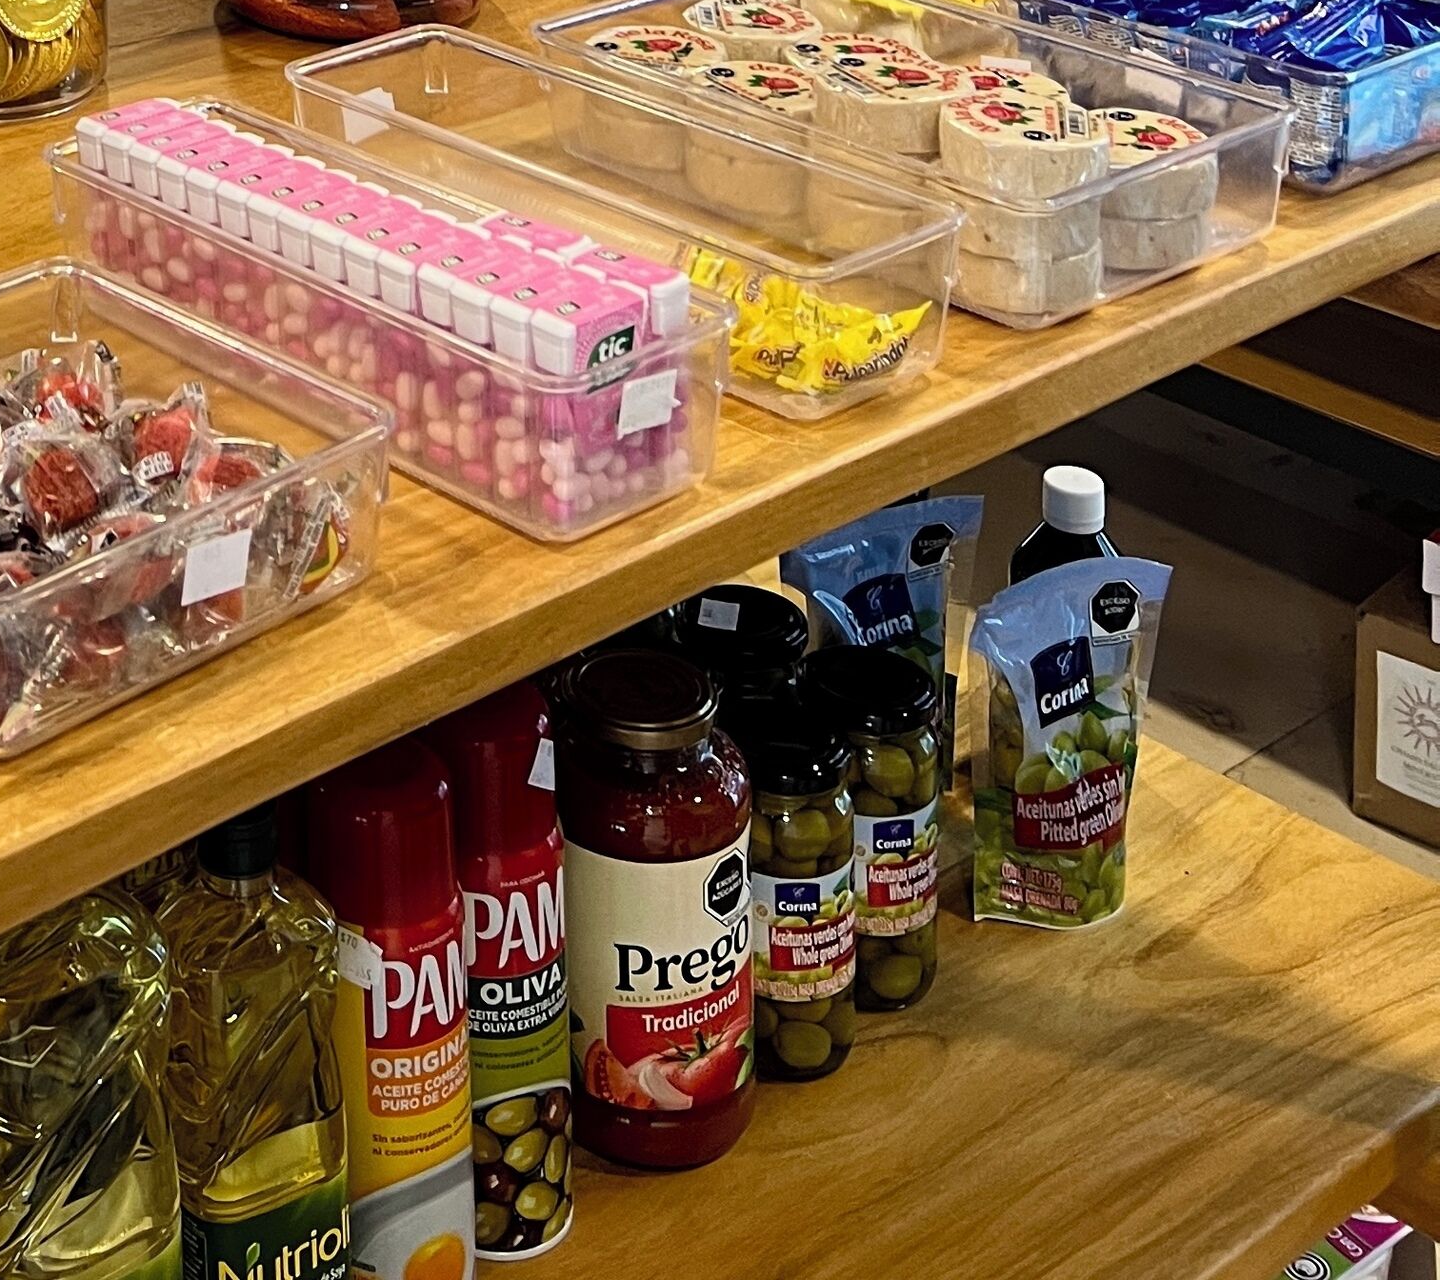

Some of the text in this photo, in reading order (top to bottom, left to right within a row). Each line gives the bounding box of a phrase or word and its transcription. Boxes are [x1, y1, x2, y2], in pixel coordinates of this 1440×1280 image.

[598, 335, 627, 361] tic
[1040, 677, 1089, 717] Corina
[1016, 797, 1075, 821] Aceitunas
[1104, 773, 1117, 801] sin
[1040, 813, 1107, 846] Pitted green
[875, 837, 913, 850] Corina
[868, 865, 907, 883] Aceitunas
[889, 880, 912, 901] Whole
[463, 865, 565, 969] PAM
[778, 900, 817, 913] Corina
[771, 924, 837, 948] Aceitunas verdes
[614, 914, 749, 993] Prego
[792, 943, 840, 968] Whole green
[371, 940, 468, 1040] PAM
[479, 962, 562, 1006] OLIVA
[618, 985, 704, 1003] SALSA ITALIANA
[641, 981, 741, 1035] Tradicional
[482, 1019, 516, 1033] OLIVA
[517, 1012, 547, 1031] EXTRA
[372, 1081, 423, 1098] ACEITE
[380, 1091, 440, 1111] PURO DE
